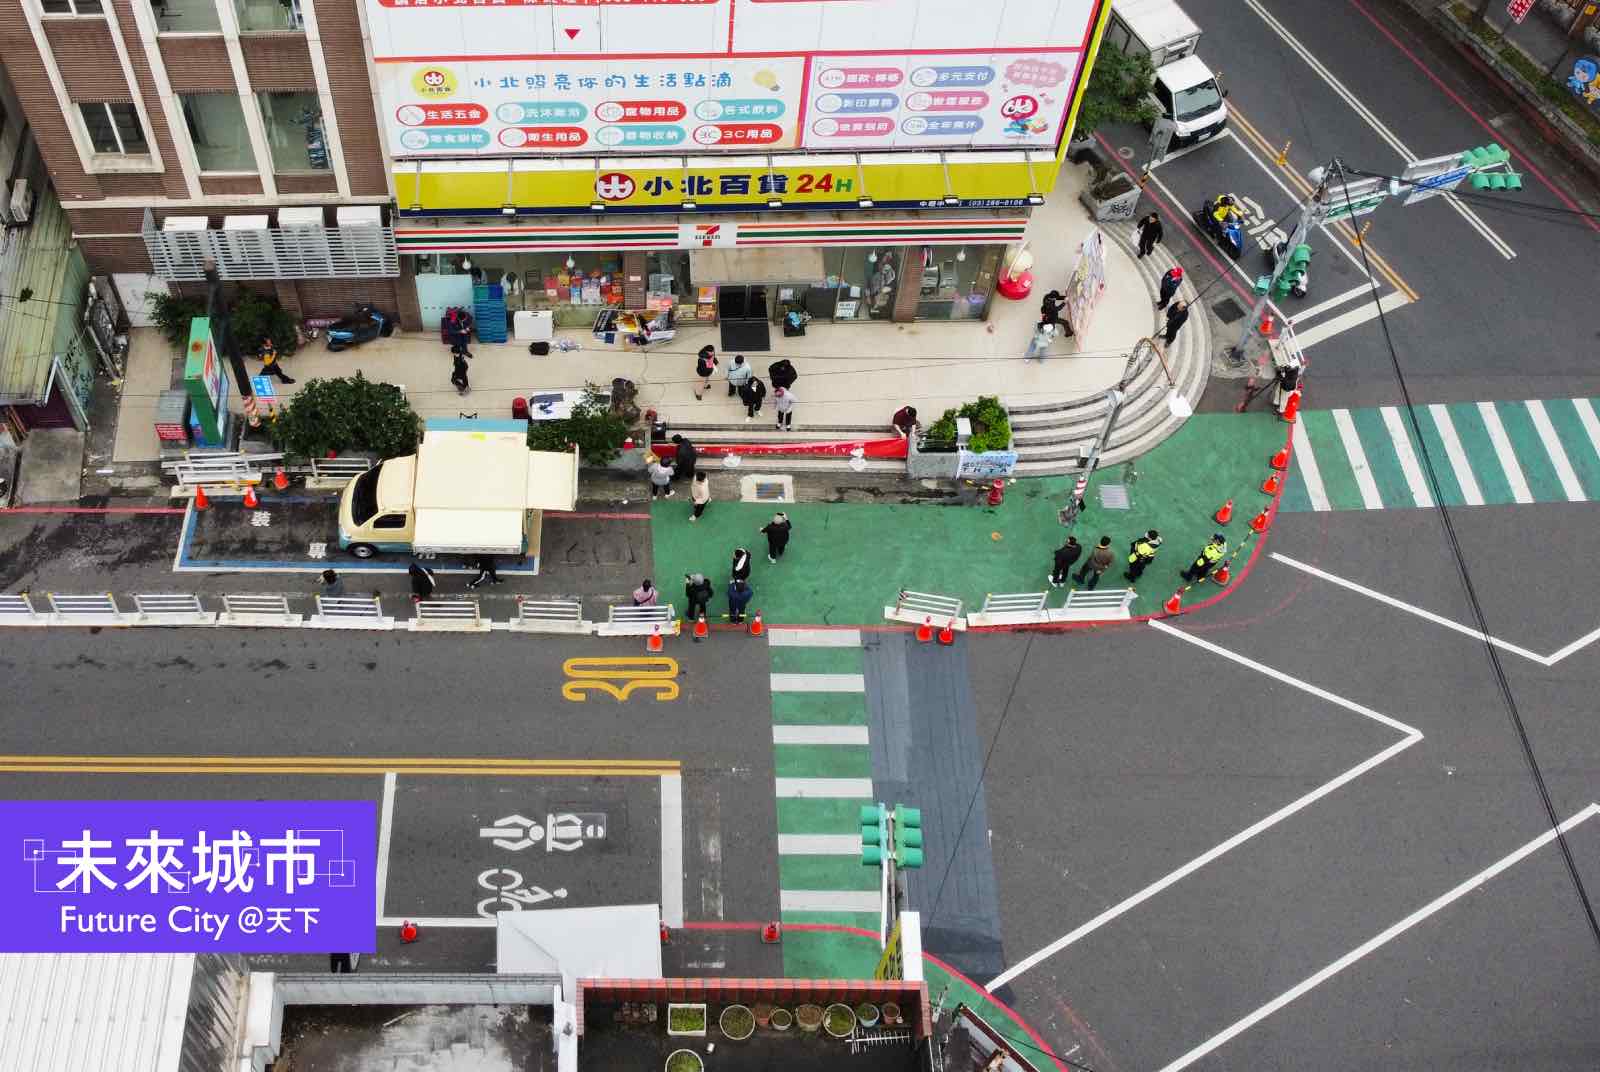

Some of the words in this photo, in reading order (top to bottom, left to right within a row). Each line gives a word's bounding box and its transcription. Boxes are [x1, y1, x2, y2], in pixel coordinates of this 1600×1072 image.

[474, 71, 733, 90] 小北照亮你的生活點滴
[426, 108, 482, 120] 生活五金
[625, 106, 680, 116] 寵物用品
[723, 129, 773, 139] 3C用品
[643, 173, 789, 196] 小北百貨
[795, 173, 853, 194] 24H
